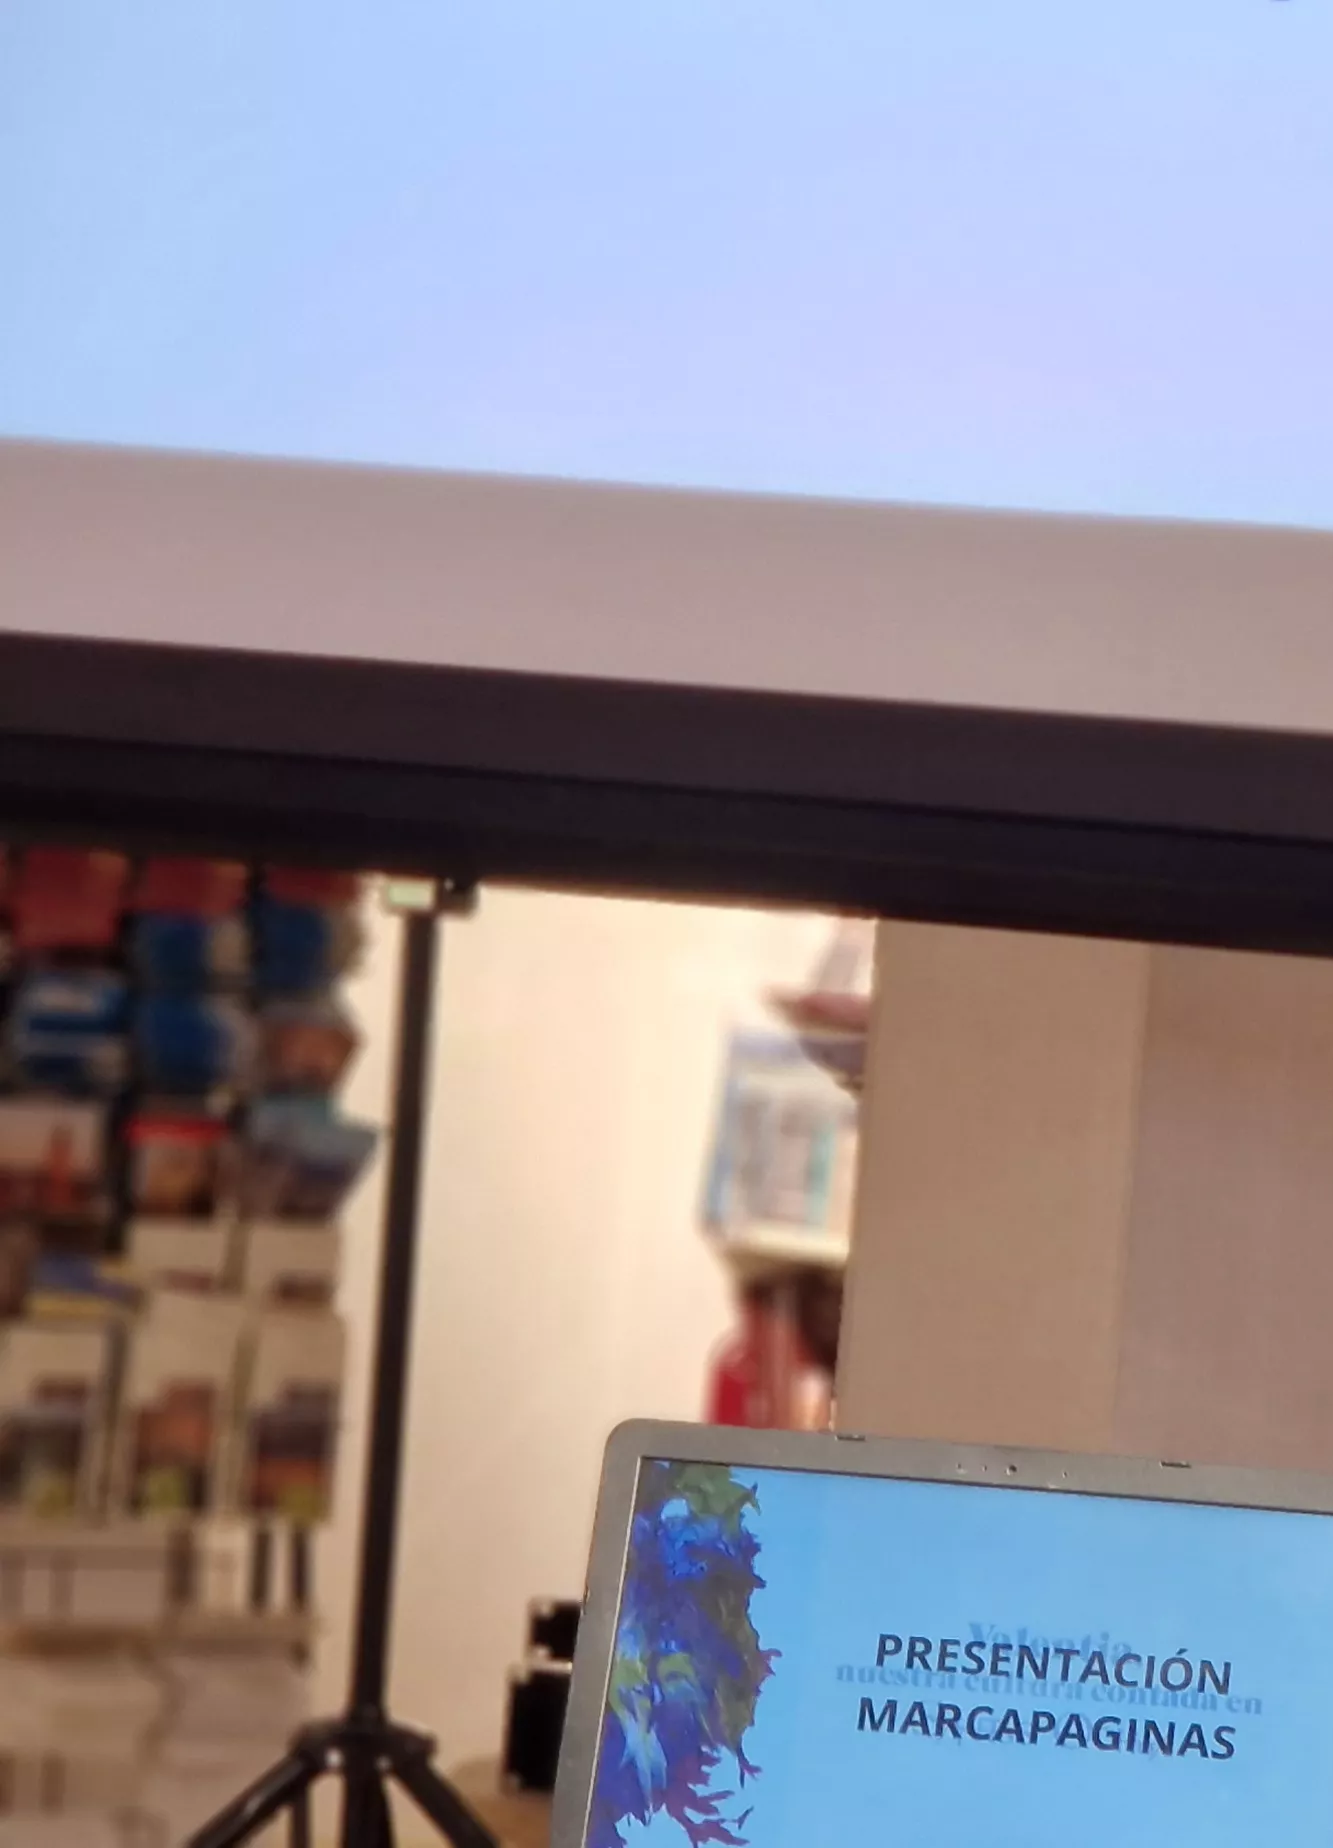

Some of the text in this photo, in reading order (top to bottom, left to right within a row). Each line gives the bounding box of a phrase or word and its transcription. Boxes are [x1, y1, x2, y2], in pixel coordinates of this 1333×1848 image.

[835, 1662, 1264, 1716] nuestra cultura contada en
[875, 1633, 1232, 1695] PRESENTACIÓN
[856, 1696, 1236, 1760] MARCAPAGINAS
